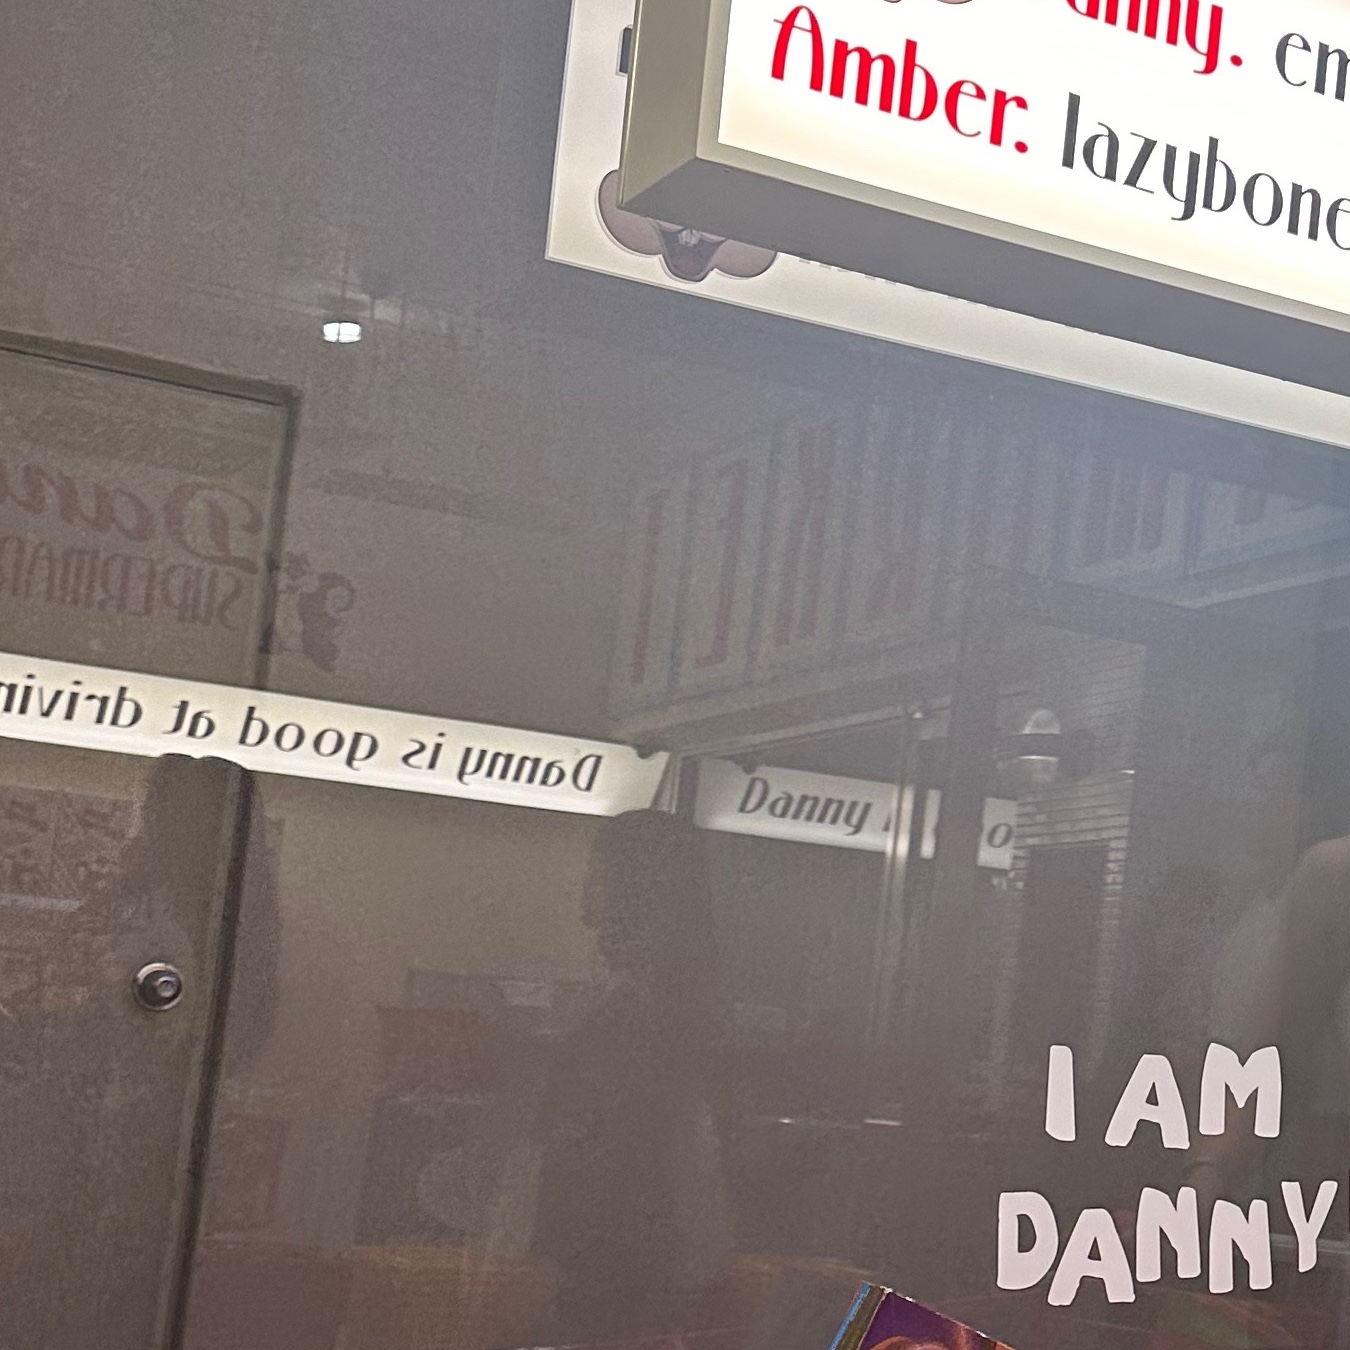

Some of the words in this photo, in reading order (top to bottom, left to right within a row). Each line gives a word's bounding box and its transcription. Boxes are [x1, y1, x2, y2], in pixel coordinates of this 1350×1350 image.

[770, 5, 1030, 154] Amber.
[1066, 0, 1243, 75] nny.
[737, 776, 872, 836] Danny
[1045, 1044, 1077, 1142] I
[1104, 1042, 1283, 1150] AM
